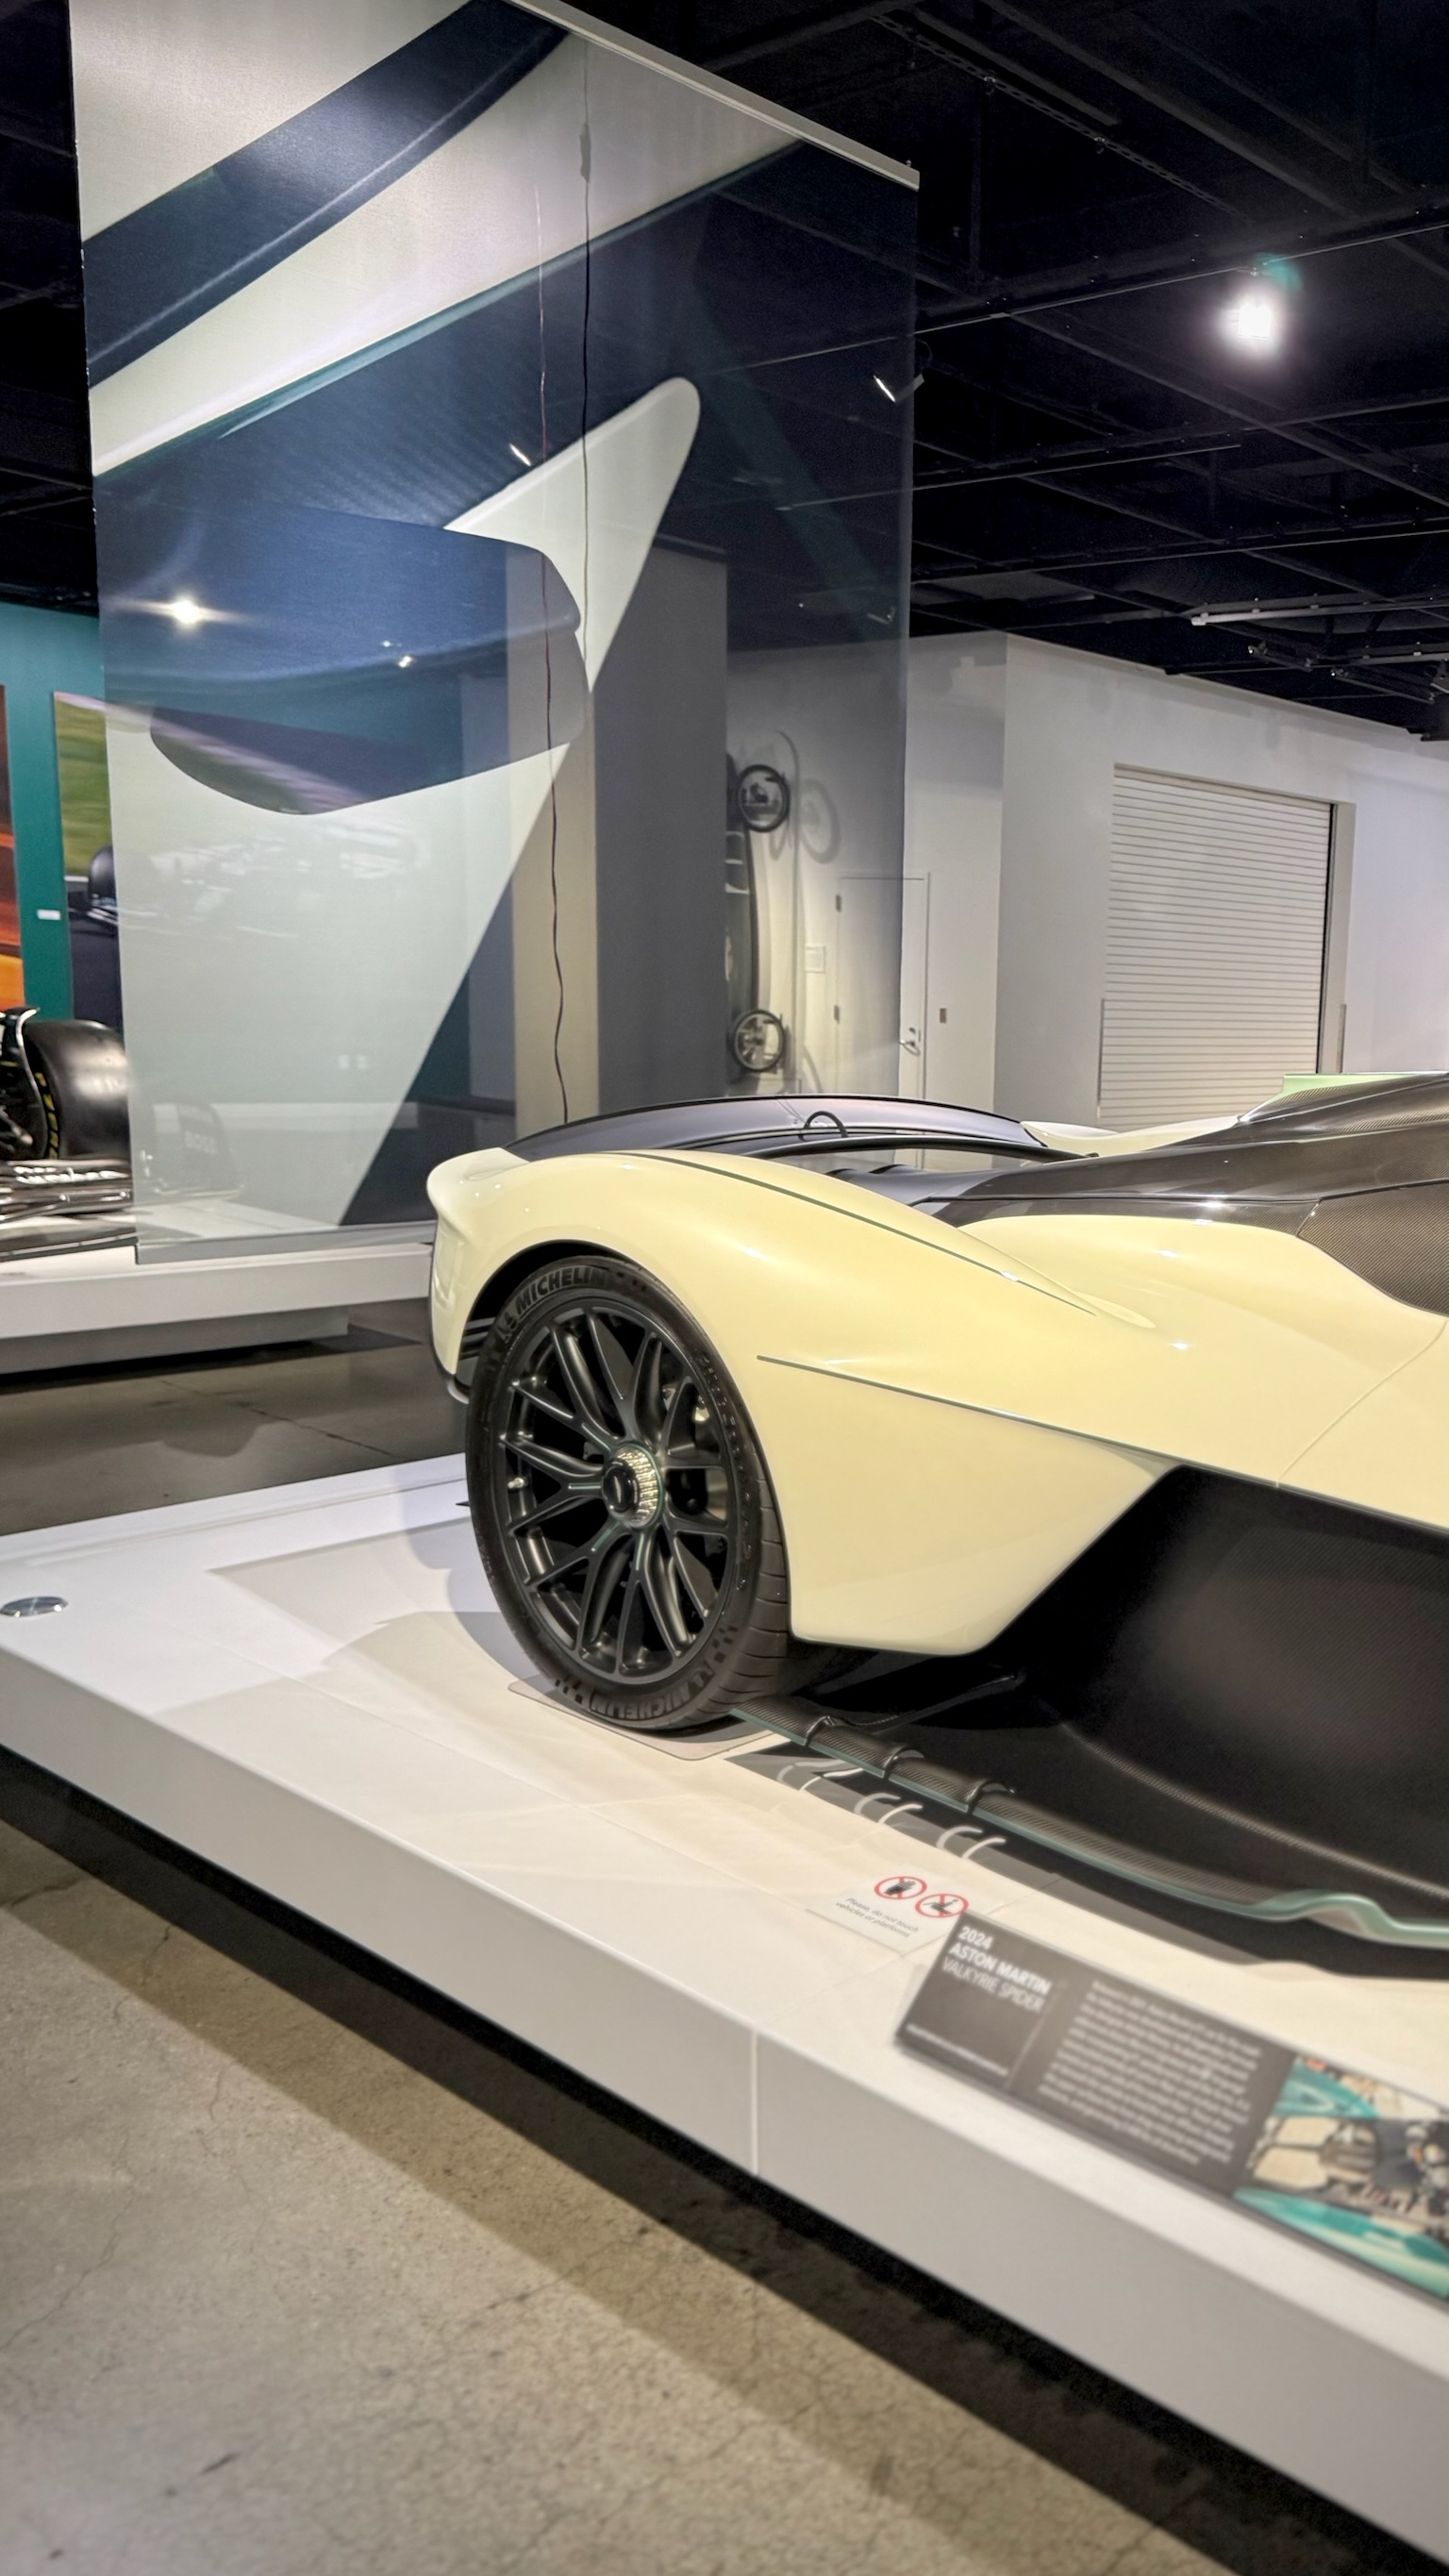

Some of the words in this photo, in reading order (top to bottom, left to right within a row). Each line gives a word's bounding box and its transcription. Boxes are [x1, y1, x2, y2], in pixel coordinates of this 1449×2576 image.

[515, 1265, 611, 1315] MICHELIN
[958, 1926, 993, 1950] 2024
[942, 1956, 1000, 1994] VALKYRIE
[998, 1982, 1045, 2014] SPIDER
[949, 1942, 997, 1972] ASTON
[996, 1961, 1052, 1996] MARTIN
